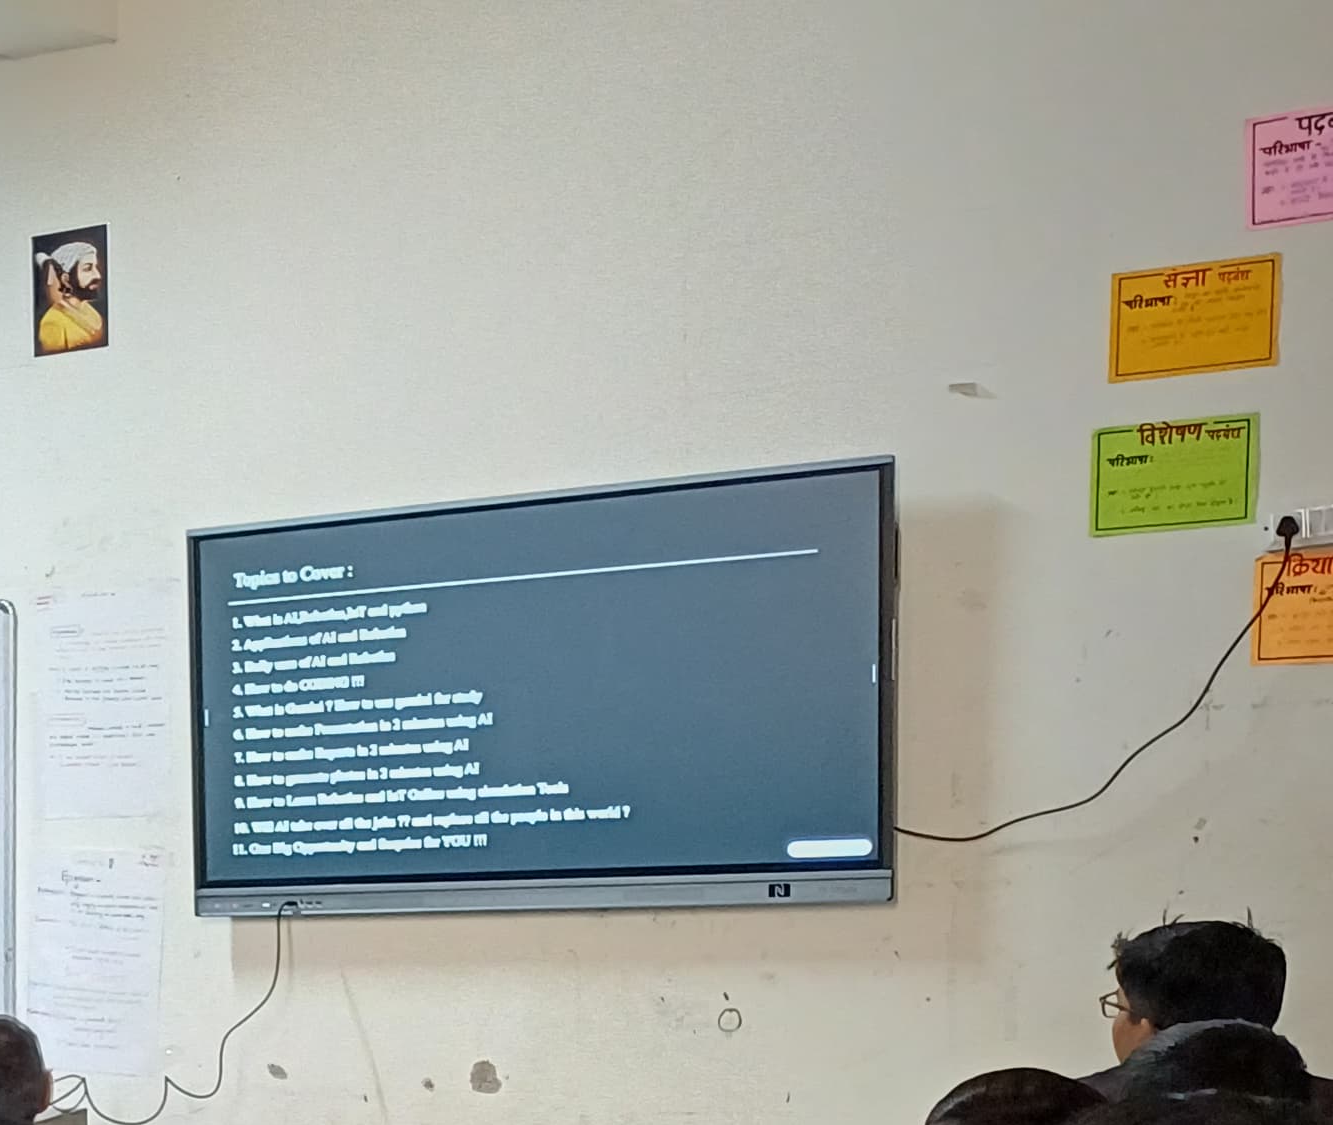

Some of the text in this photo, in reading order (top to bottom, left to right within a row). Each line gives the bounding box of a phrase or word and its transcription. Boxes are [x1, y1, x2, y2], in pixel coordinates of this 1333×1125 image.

[1137, 421, 1208, 446] विशेषण
[233, 570, 280, 590] Topics
[283, 570, 297, 583] to
[300, 566, 345, 581] Cover
[478, 712, 493, 724] AI
[454, 738, 469, 751] AI
[465, 762, 479, 774] AI
[442, 835, 471, 847] YOU
